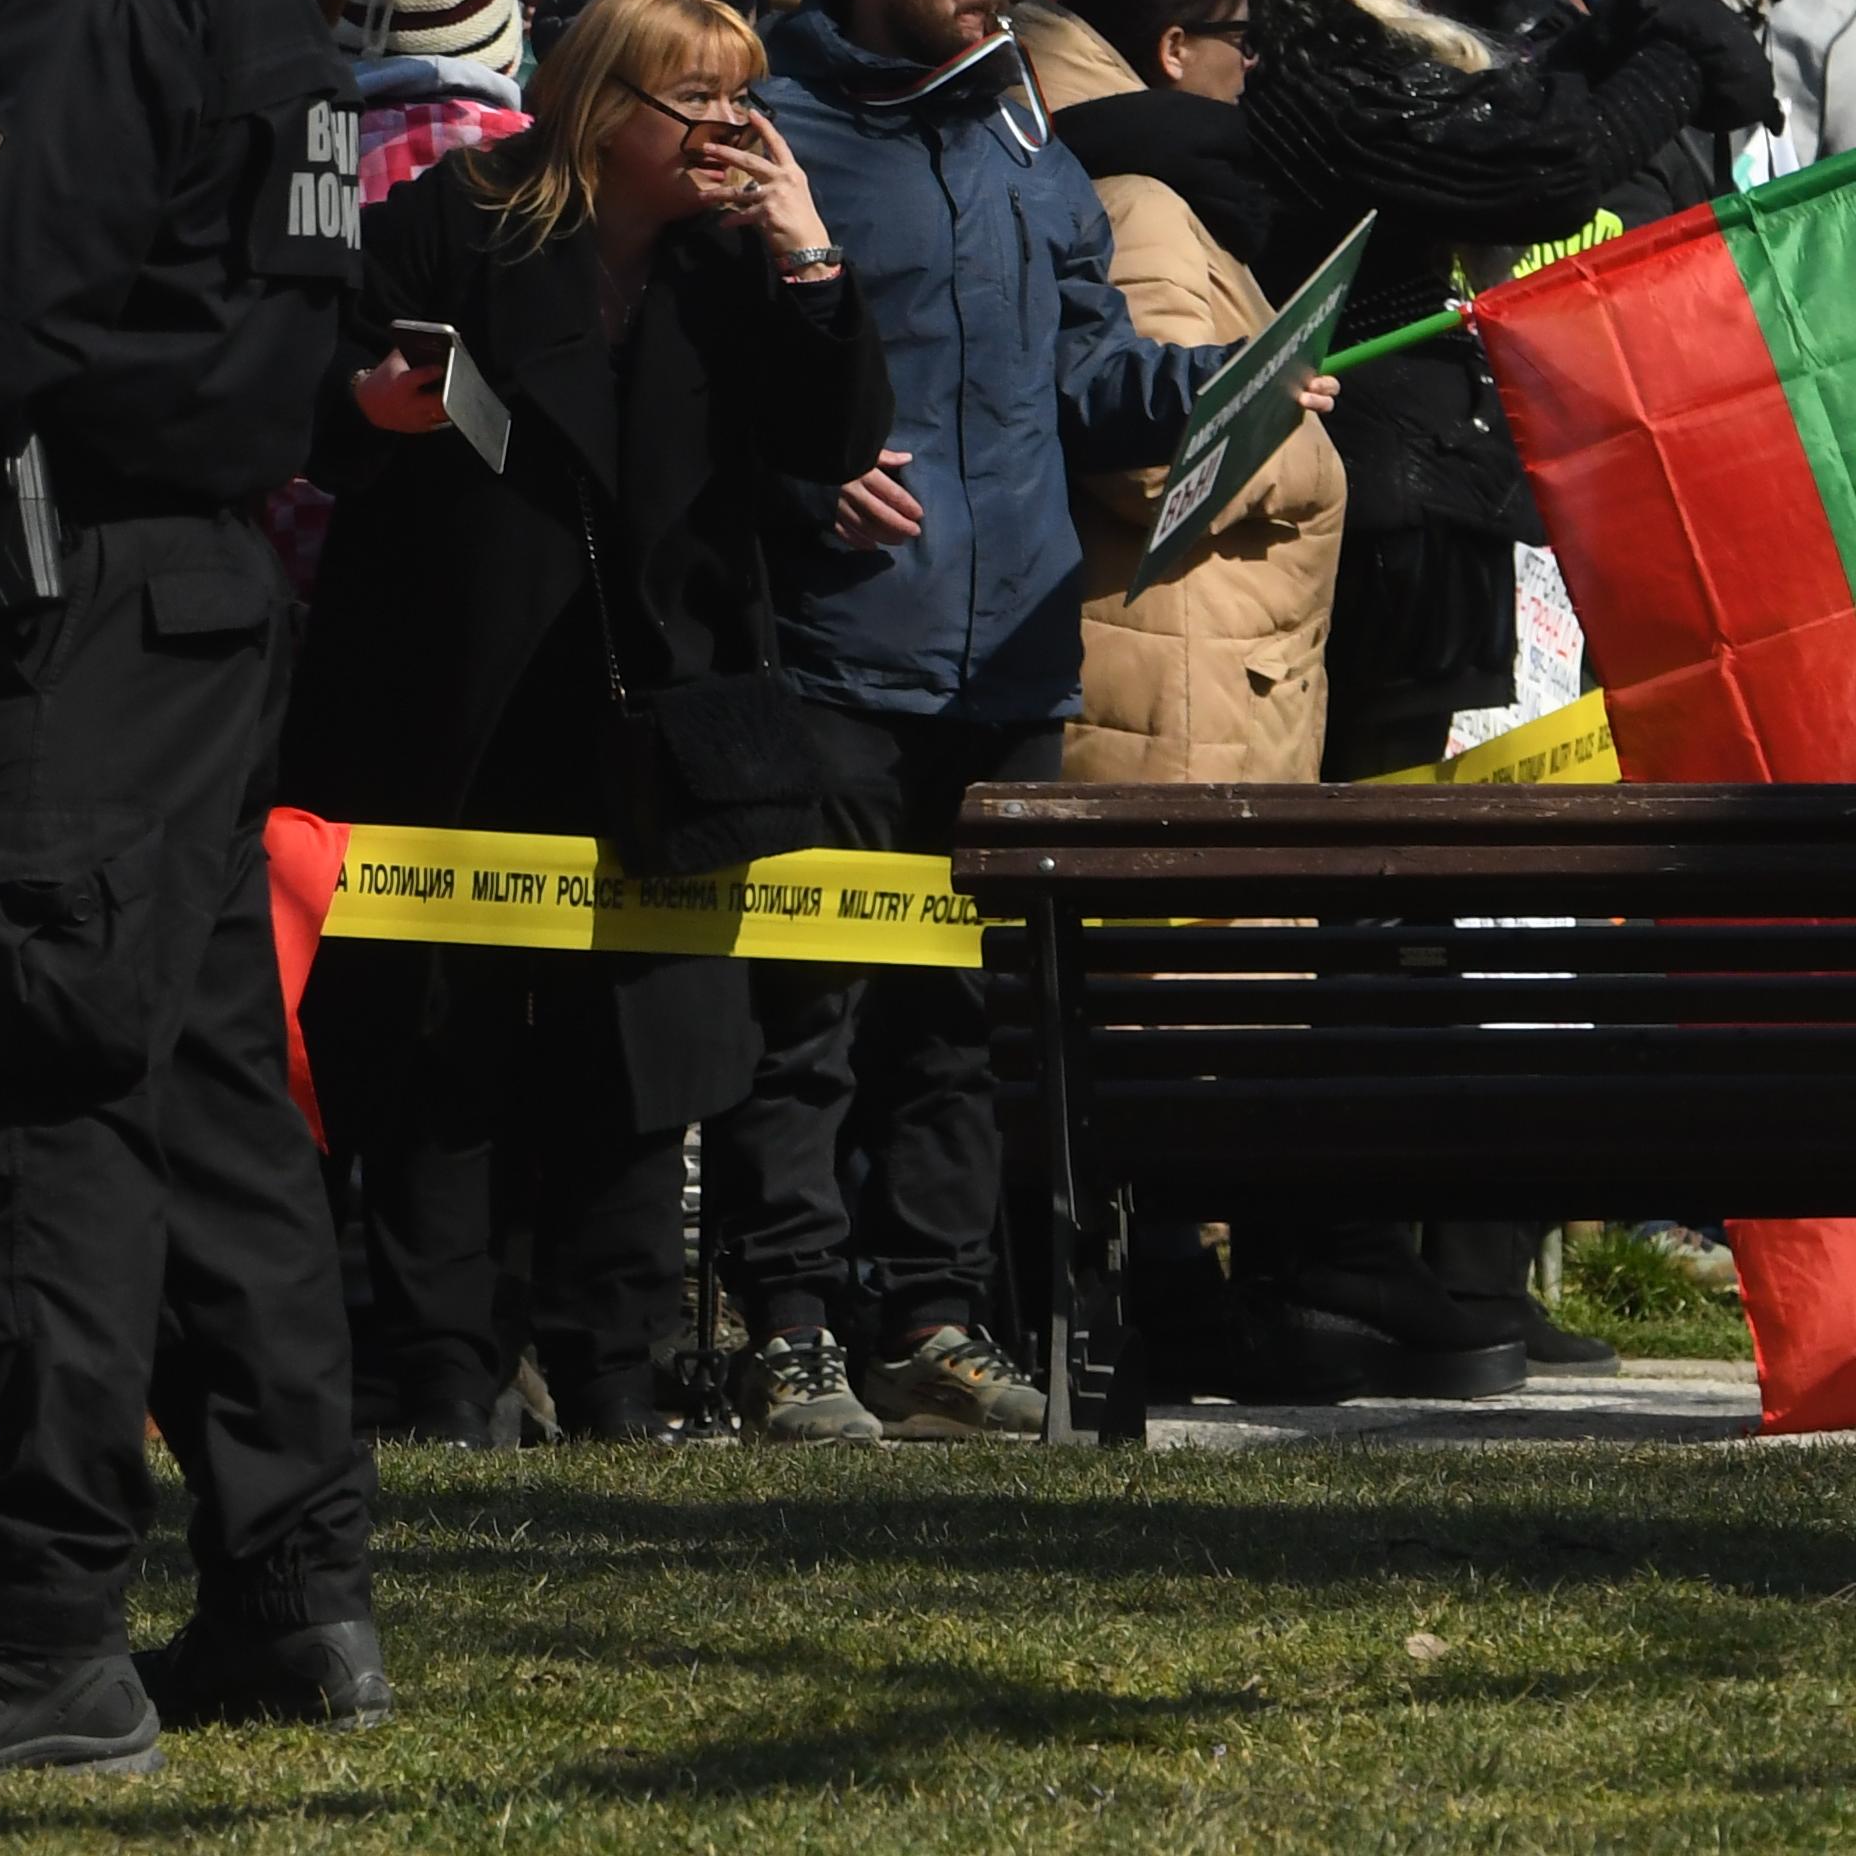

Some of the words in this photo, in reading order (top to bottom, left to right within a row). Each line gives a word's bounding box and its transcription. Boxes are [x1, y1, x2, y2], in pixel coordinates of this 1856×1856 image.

[358, 862, 456, 901] ПОЛИЦИЯ
[471, 869, 548, 905] MILITRY
[556, 873, 625, 911] POLICE
[638, 878, 719, 913] ВОЕННА
[728, 883, 823, 919] ПОЛИЦИЯ
[837, 889, 915, 922] MILITRY
